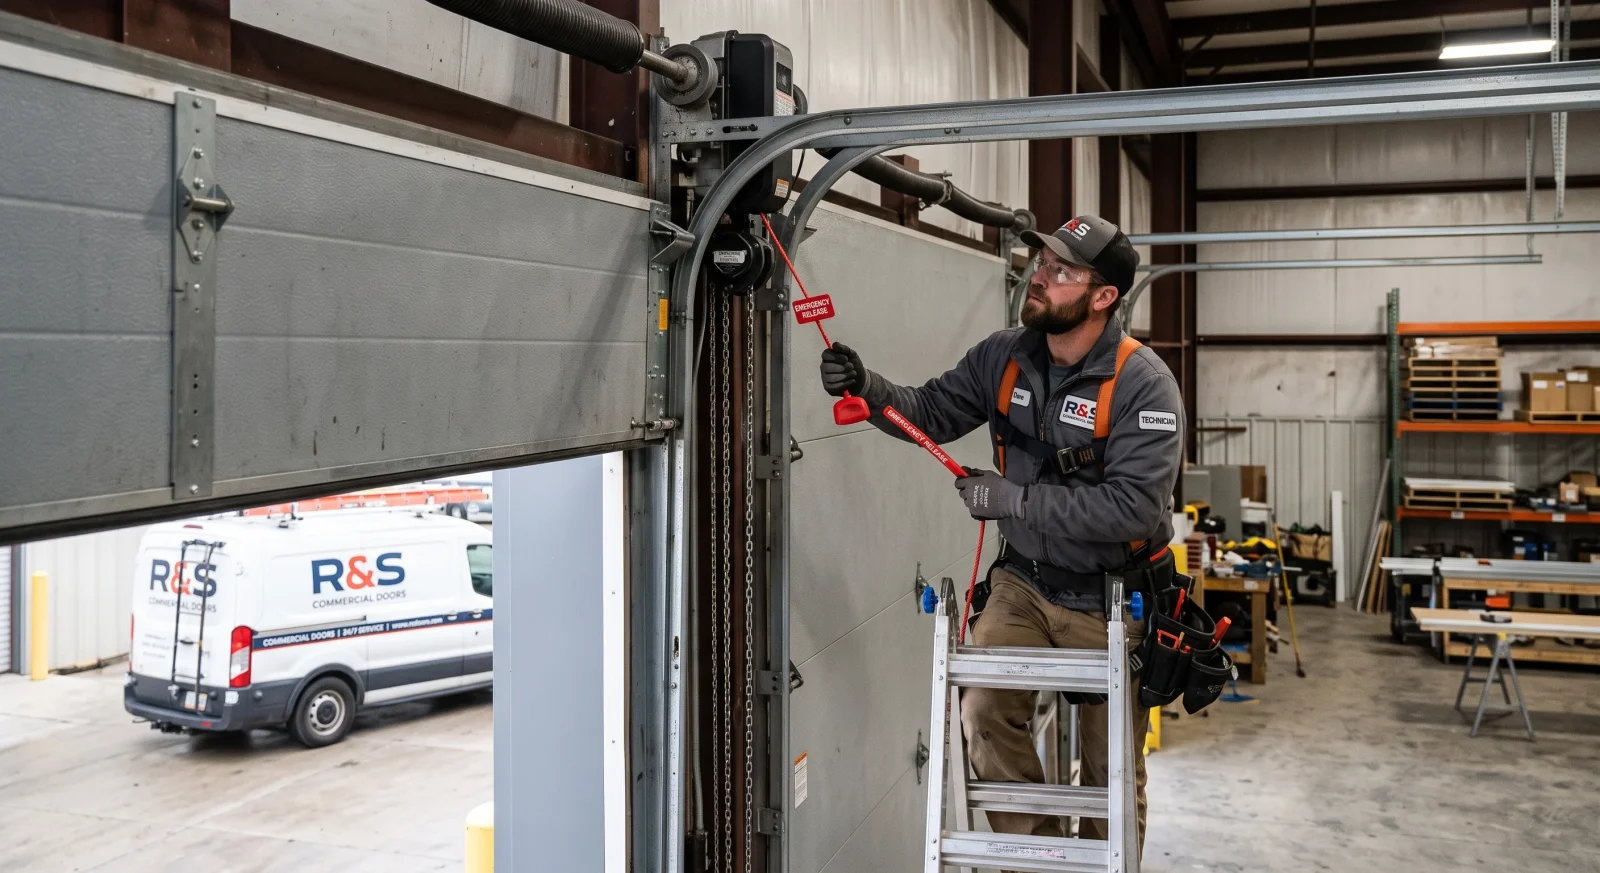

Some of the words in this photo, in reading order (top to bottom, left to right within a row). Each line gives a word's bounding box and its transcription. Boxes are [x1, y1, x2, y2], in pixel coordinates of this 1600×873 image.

[795, 298, 830, 312] EMERGENCY
[802, 307, 828, 318] RELEASE
[1141, 416, 1175, 426] TECHNICIAN
[887, 409, 925, 442] EMERGENCY
[923, 440, 948, 464] RELEASE
[150, 558, 217, 598] R&S
[311, 552, 405, 594] R&S
[312, 594, 374, 609] COMMERCIAL
[376, 590, 406, 601] DOORS
[262, 633, 310, 647] COMMERCIAL
[310, 629, 336, 640] DOORS
[342, 627, 358, 636] 24/7
[358, 623, 385, 634] SERVICE
